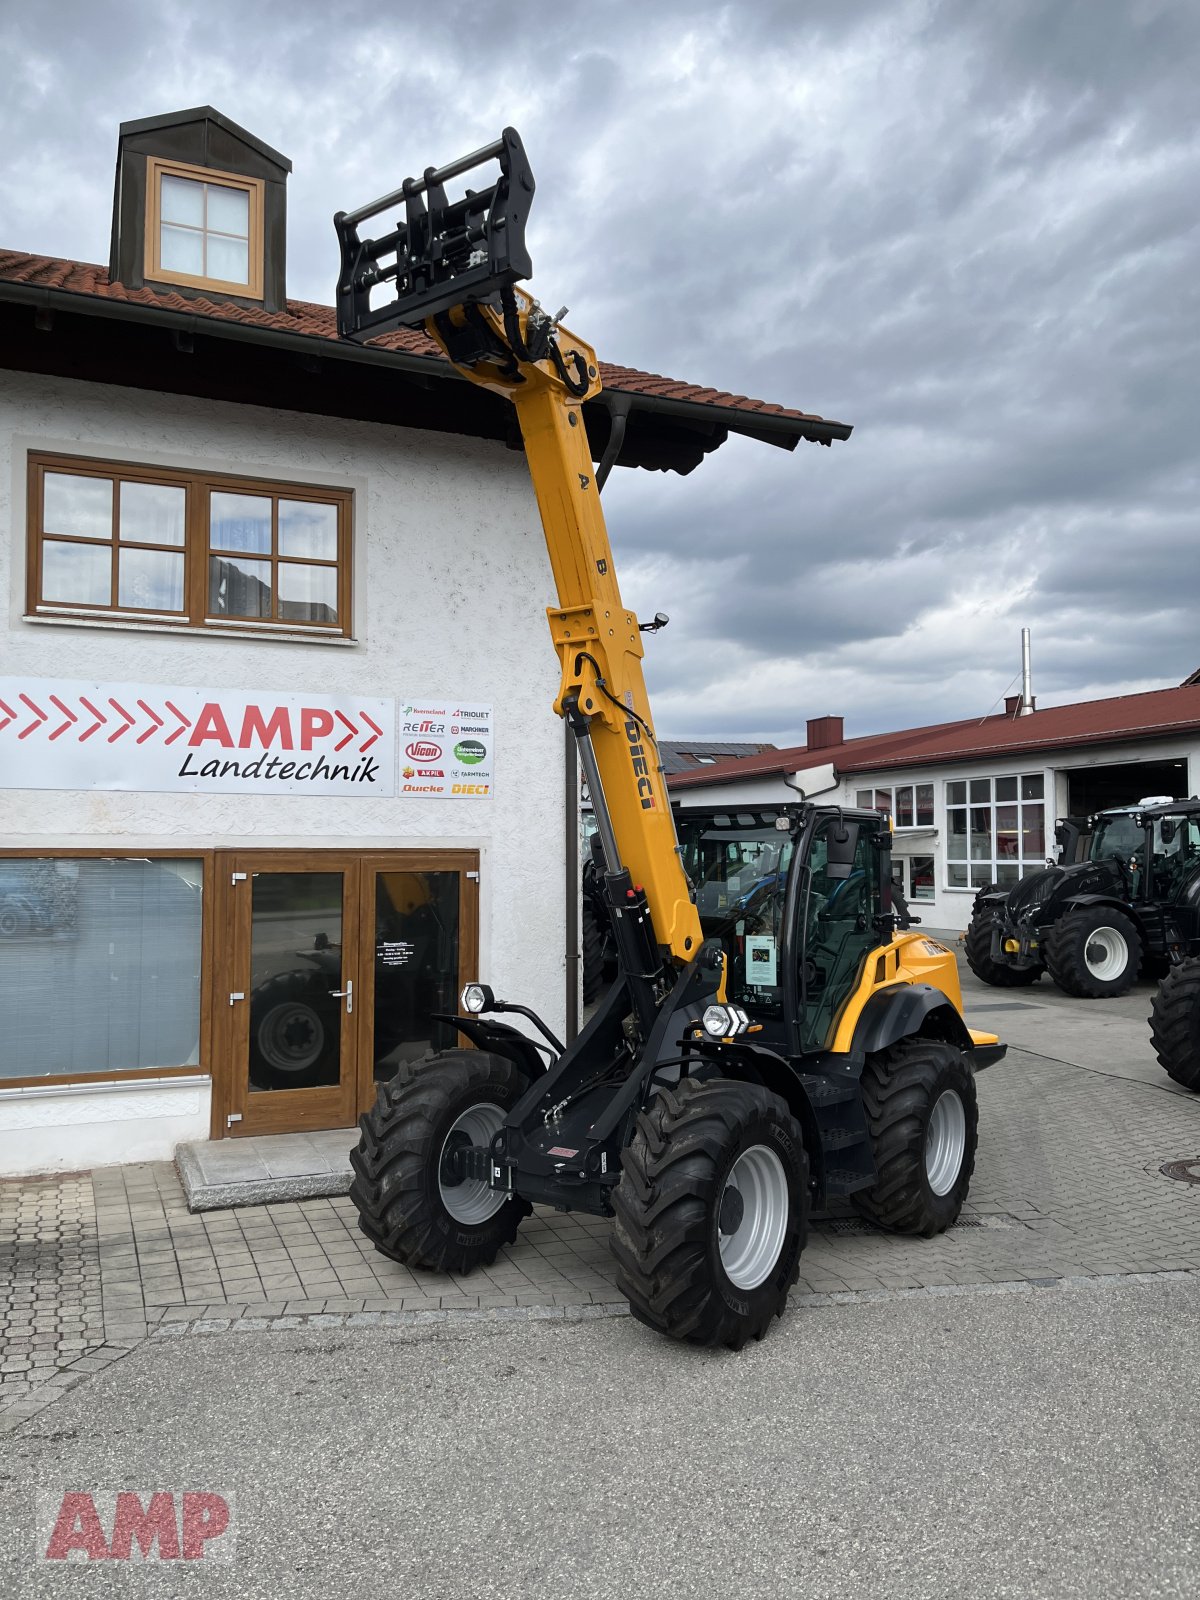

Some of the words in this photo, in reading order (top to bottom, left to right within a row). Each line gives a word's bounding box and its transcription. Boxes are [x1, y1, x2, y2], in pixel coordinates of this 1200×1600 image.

[413, 708, 446, 716] Kverneland
[187, 702, 335, 751] AMP
[402, 720, 445, 733] REITER
[411, 742, 438, 757] Vicon
[178, 752, 380, 783] Landtechnik
[403, 784, 444, 793] Quicke
